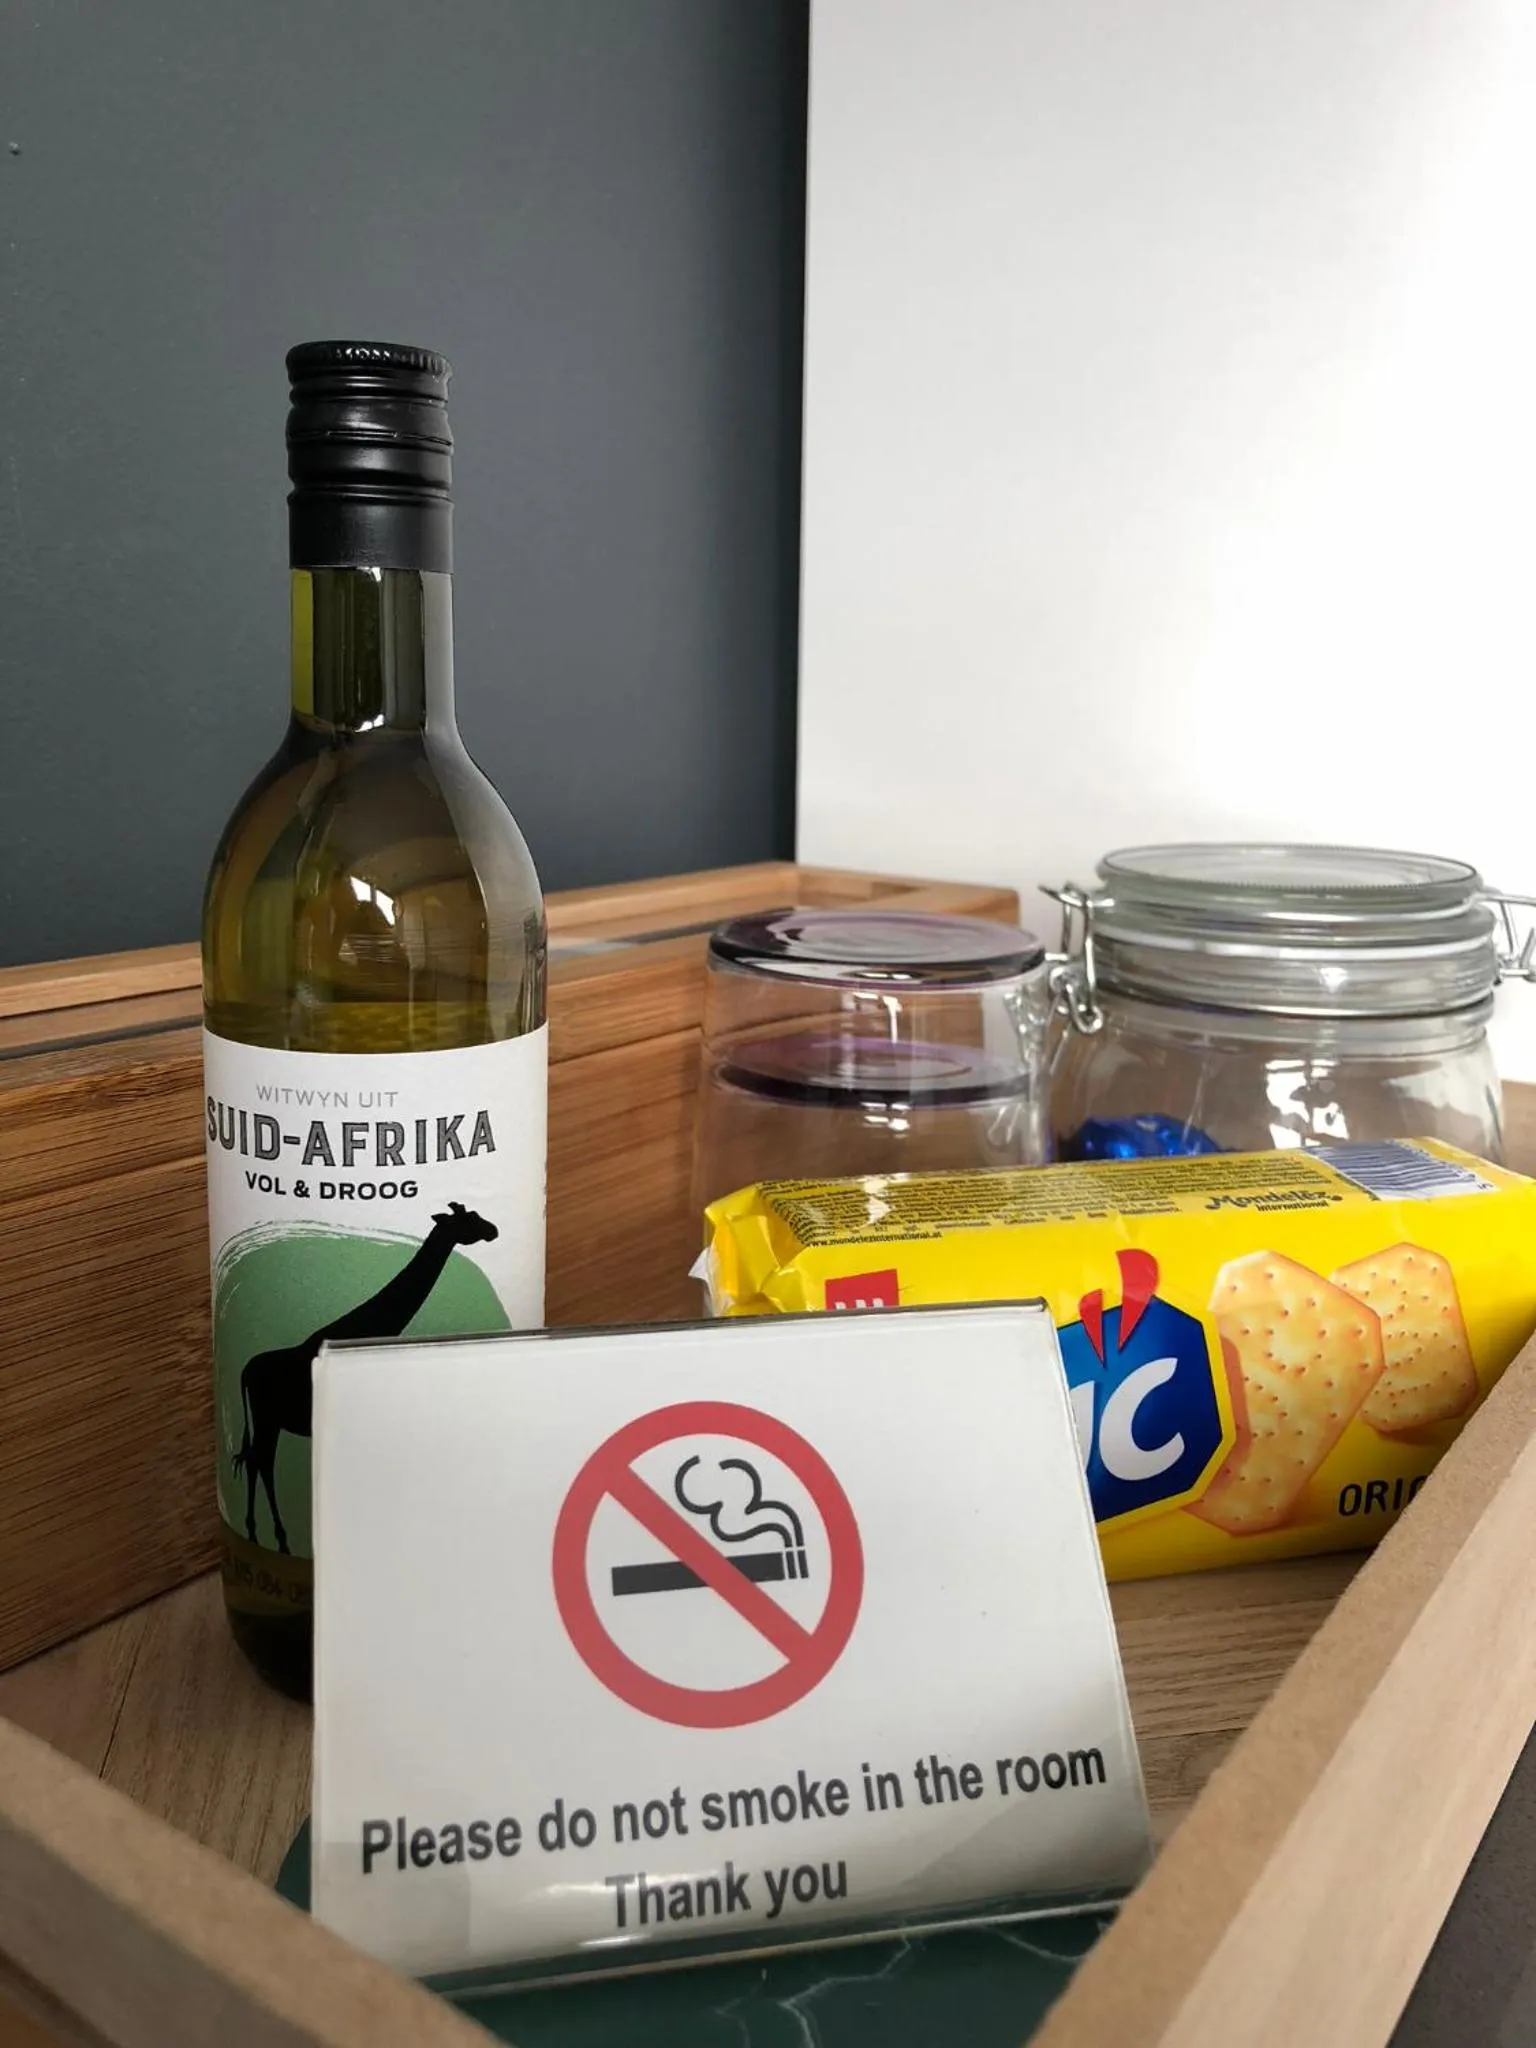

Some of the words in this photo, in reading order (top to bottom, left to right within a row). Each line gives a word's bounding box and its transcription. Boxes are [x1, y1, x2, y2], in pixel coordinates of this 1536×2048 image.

[207, 1095, 497, 1167] SUID-AFRIKA
[256, 1084, 349, 1109] WITWYN
[357, 1091, 399, 1109] UIT
[245, 1170, 287, 1196] VOL
[293, 1179, 311, 1198] &
[319, 1180, 419, 1200] DROOG
[361, 1815, 521, 1874] Please
[538, 1798, 597, 1852] do
[613, 1786, 690, 1843] not
[701, 1770, 850, 1831] smoke
[861, 1762, 904, 1812] in
[913, 1753, 985, 1806] the
[996, 1745, 1107, 1797] room
[604, 1861, 751, 1928] Thank
[764, 1857, 849, 1919] you
